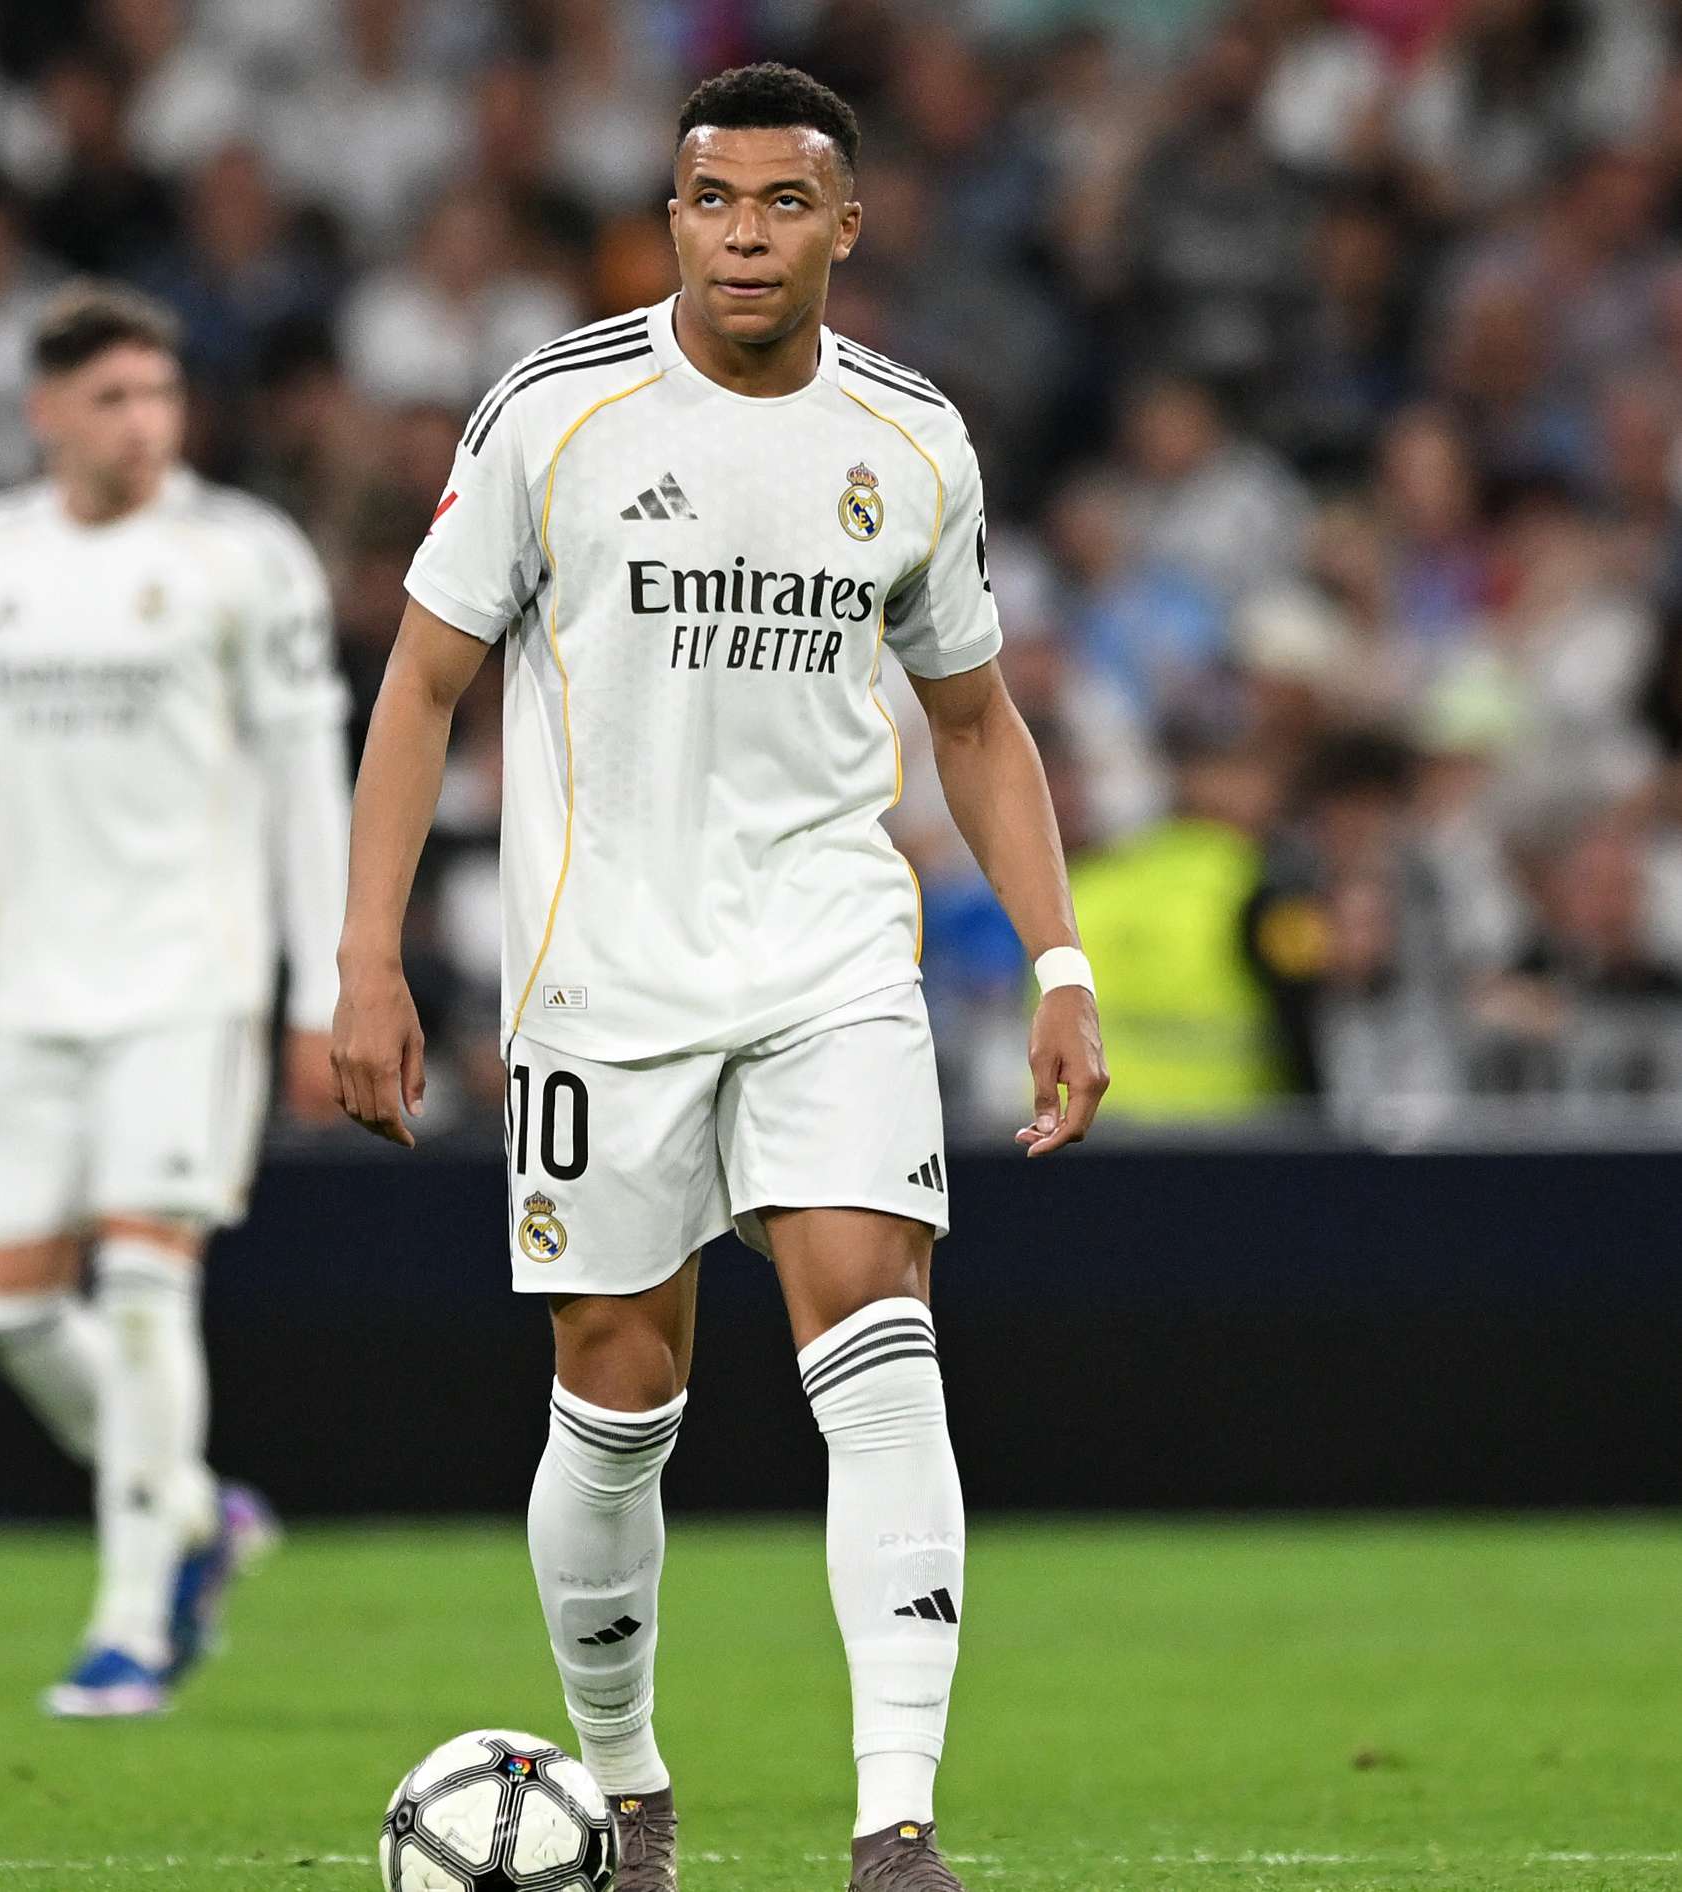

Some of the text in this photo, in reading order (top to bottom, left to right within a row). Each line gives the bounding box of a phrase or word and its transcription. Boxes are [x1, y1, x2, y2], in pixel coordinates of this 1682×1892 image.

[626, 556, 876, 622] Emirates
[670, 624, 843, 674] FLY BETTER
[512, 1064, 589, 1181] 10
